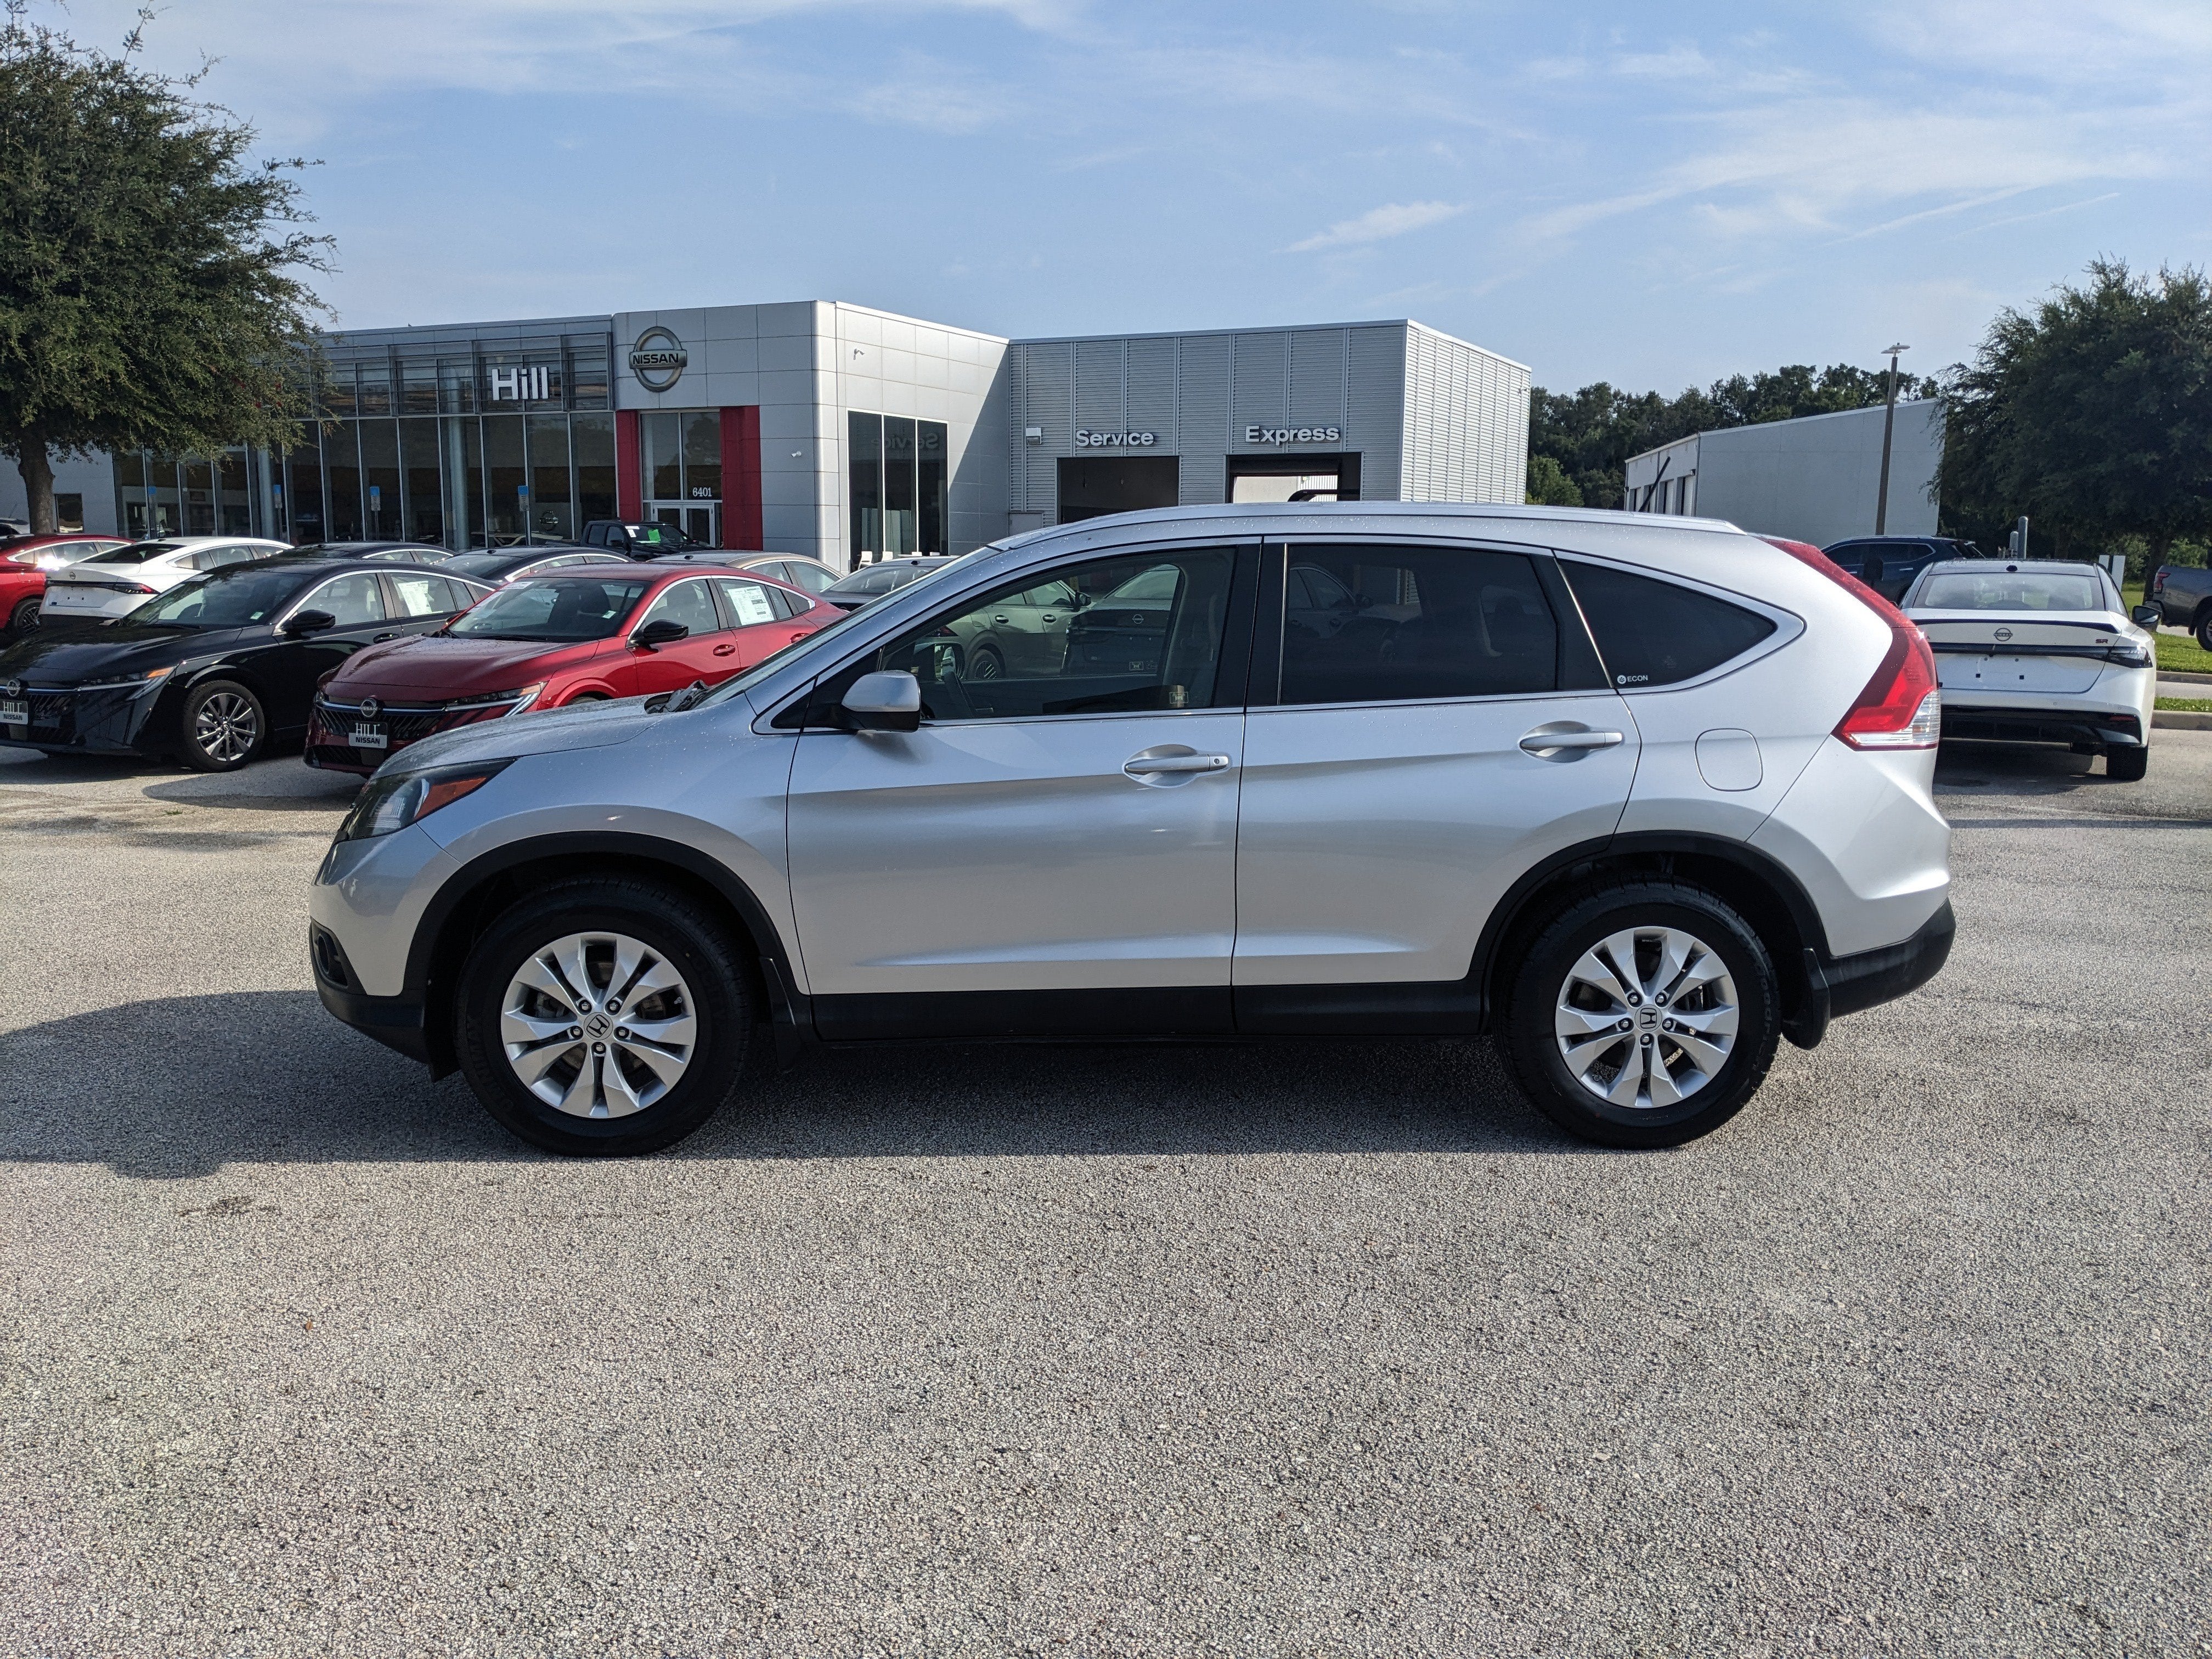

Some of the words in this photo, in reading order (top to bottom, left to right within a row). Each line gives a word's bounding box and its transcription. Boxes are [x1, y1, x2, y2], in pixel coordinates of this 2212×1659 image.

[633, 353, 679, 364] NISSAN
[492, 366, 549, 400] Hill
[1075, 430, 1154, 447] Service
[1245, 425, 1339, 446] Express
[692, 487, 712, 497] 6401
[3, 701, 22, 714] HILL
[355, 723, 381, 737] HILL
